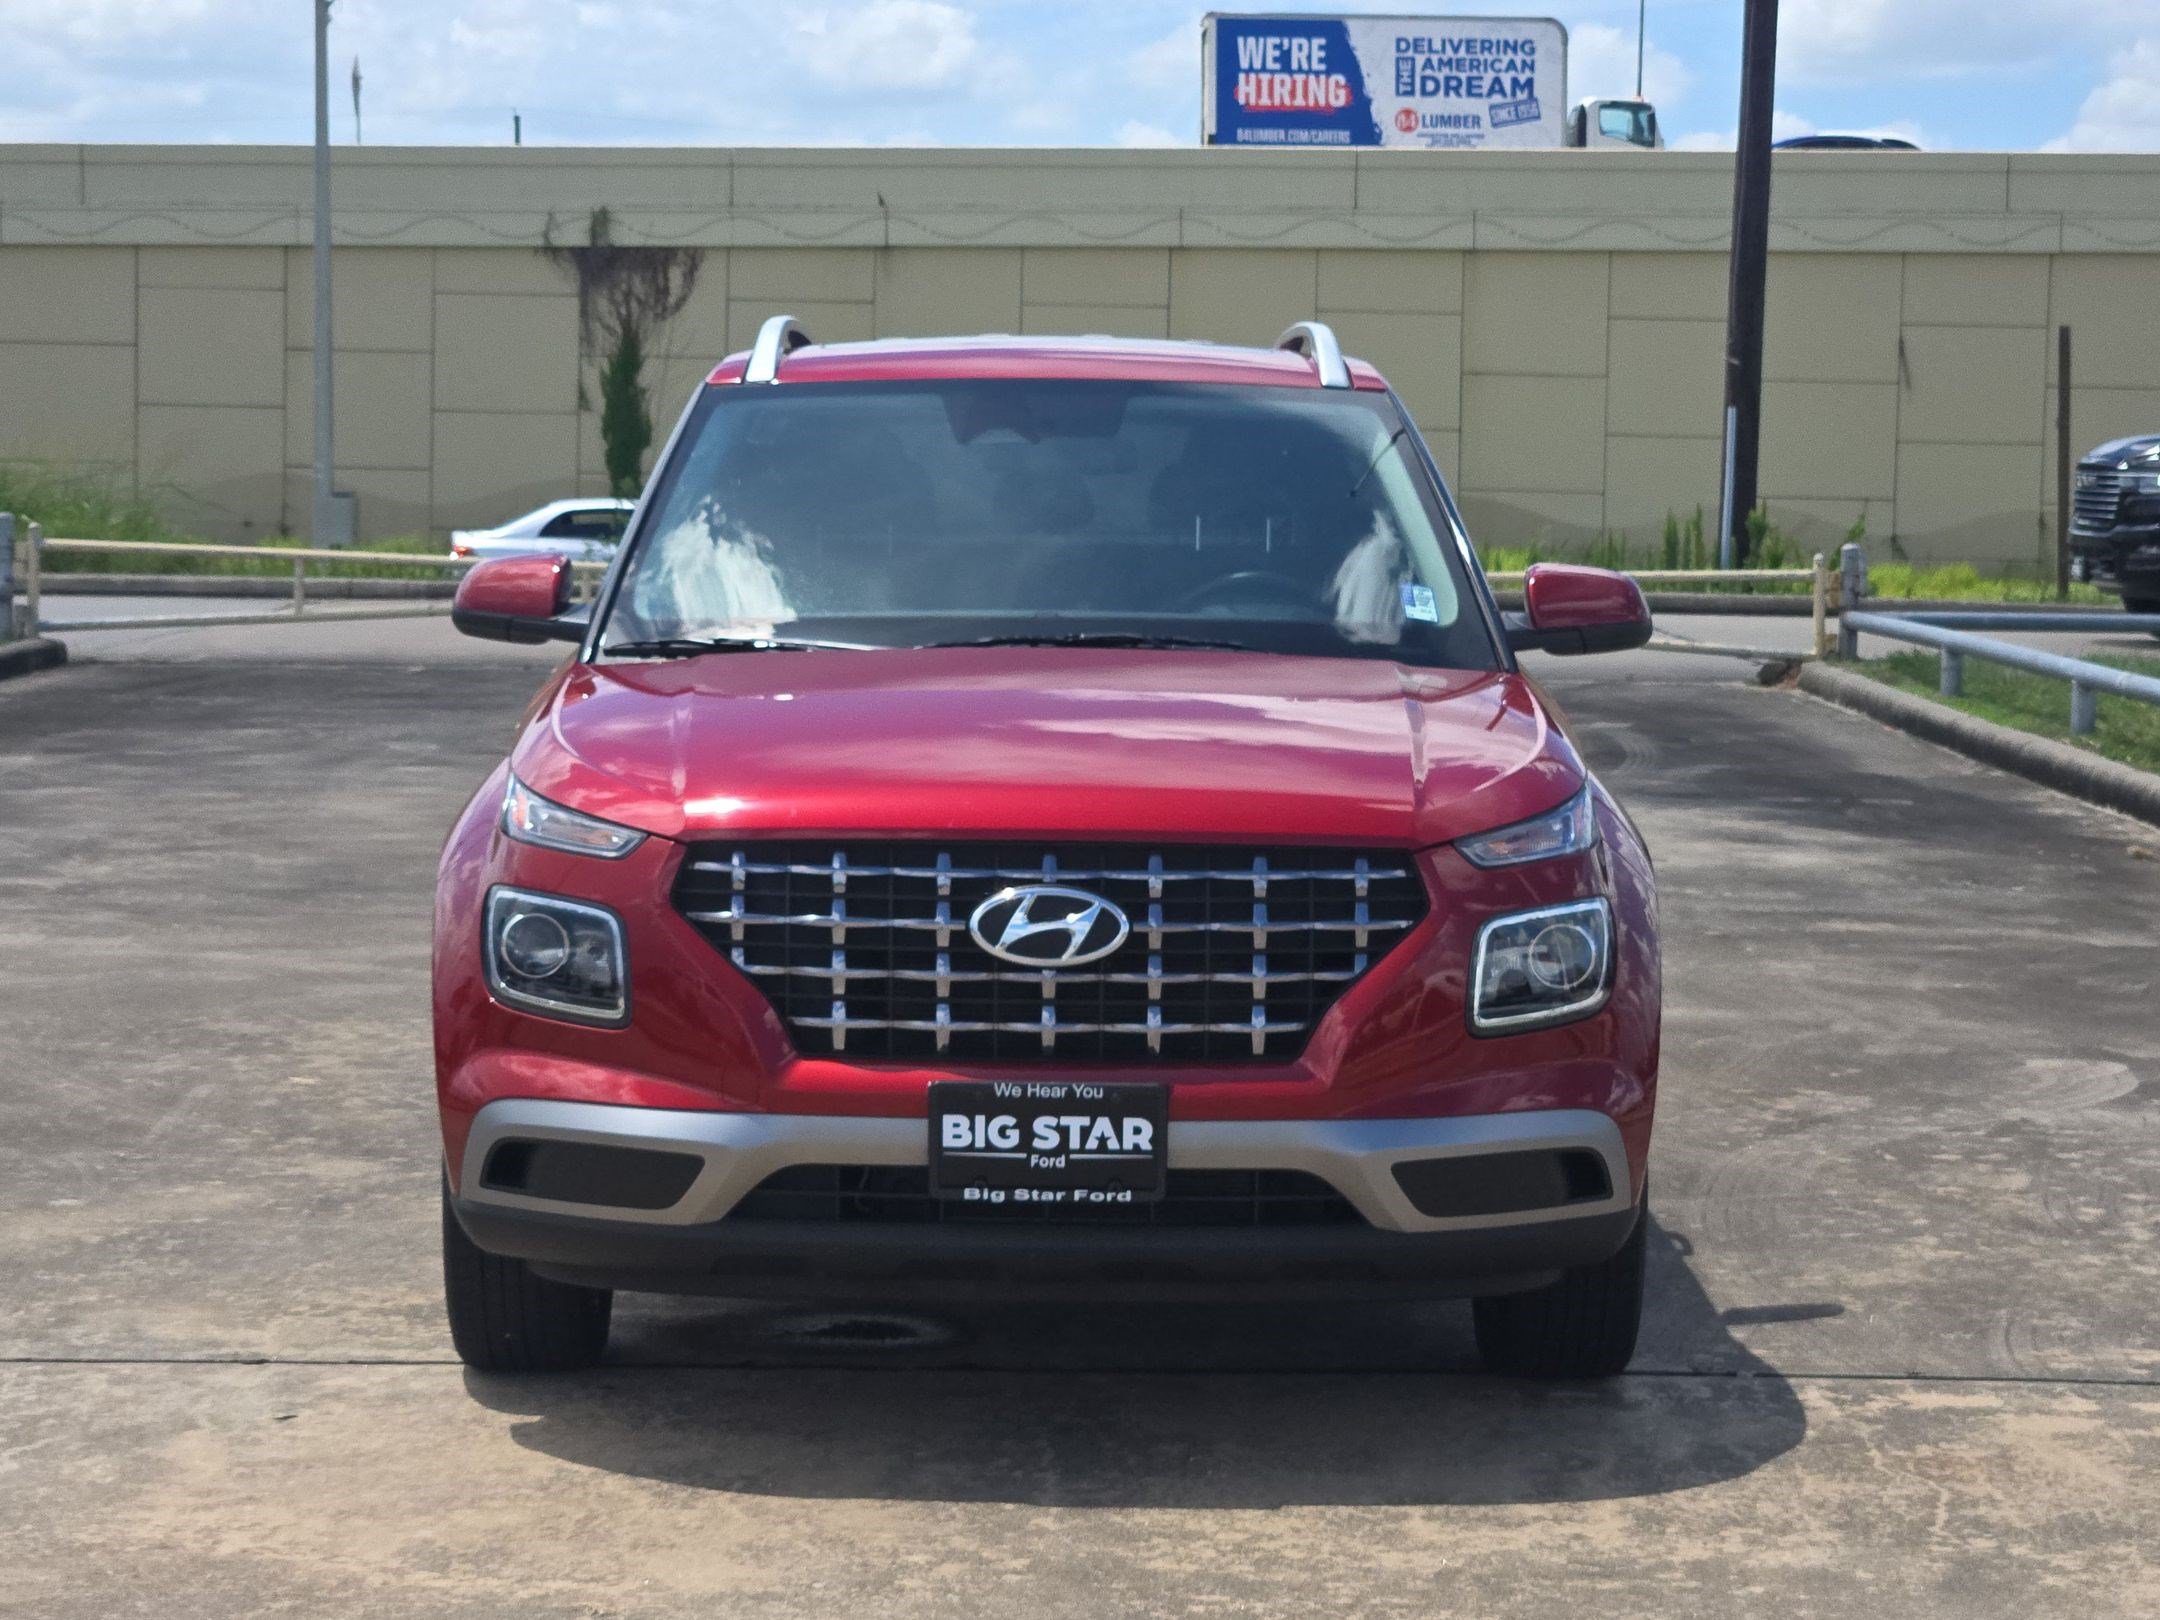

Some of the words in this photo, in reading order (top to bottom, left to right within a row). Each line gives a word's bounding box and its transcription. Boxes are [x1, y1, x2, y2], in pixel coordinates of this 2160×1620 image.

[1237, 37, 1326, 71] WE'RE
[1395, 37, 1536, 56] DELIVERING
[1421, 57, 1535, 74] AMERICAN
[1399, 58, 1412, 95] THE
[1238, 73, 1346, 107] HIRING
[1420, 75, 1534, 99] DREAM
[1421, 114, 1481, 129] LUMBER
[994, 1082, 1022, 1098] We
[1027, 1083, 1067, 1098] Hear
[1073, 1083, 1104, 1098] You
[942, 1114, 1020, 1149] BIG
[1032, 1115, 1153, 1151] STAR
[1030, 1154, 1066, 1168] Ford
[963, 1187, 1006, 1203] Big
[1013, 1188, 1067, 1202] Star
[1073, 1188, 1132, 1202] Ford
